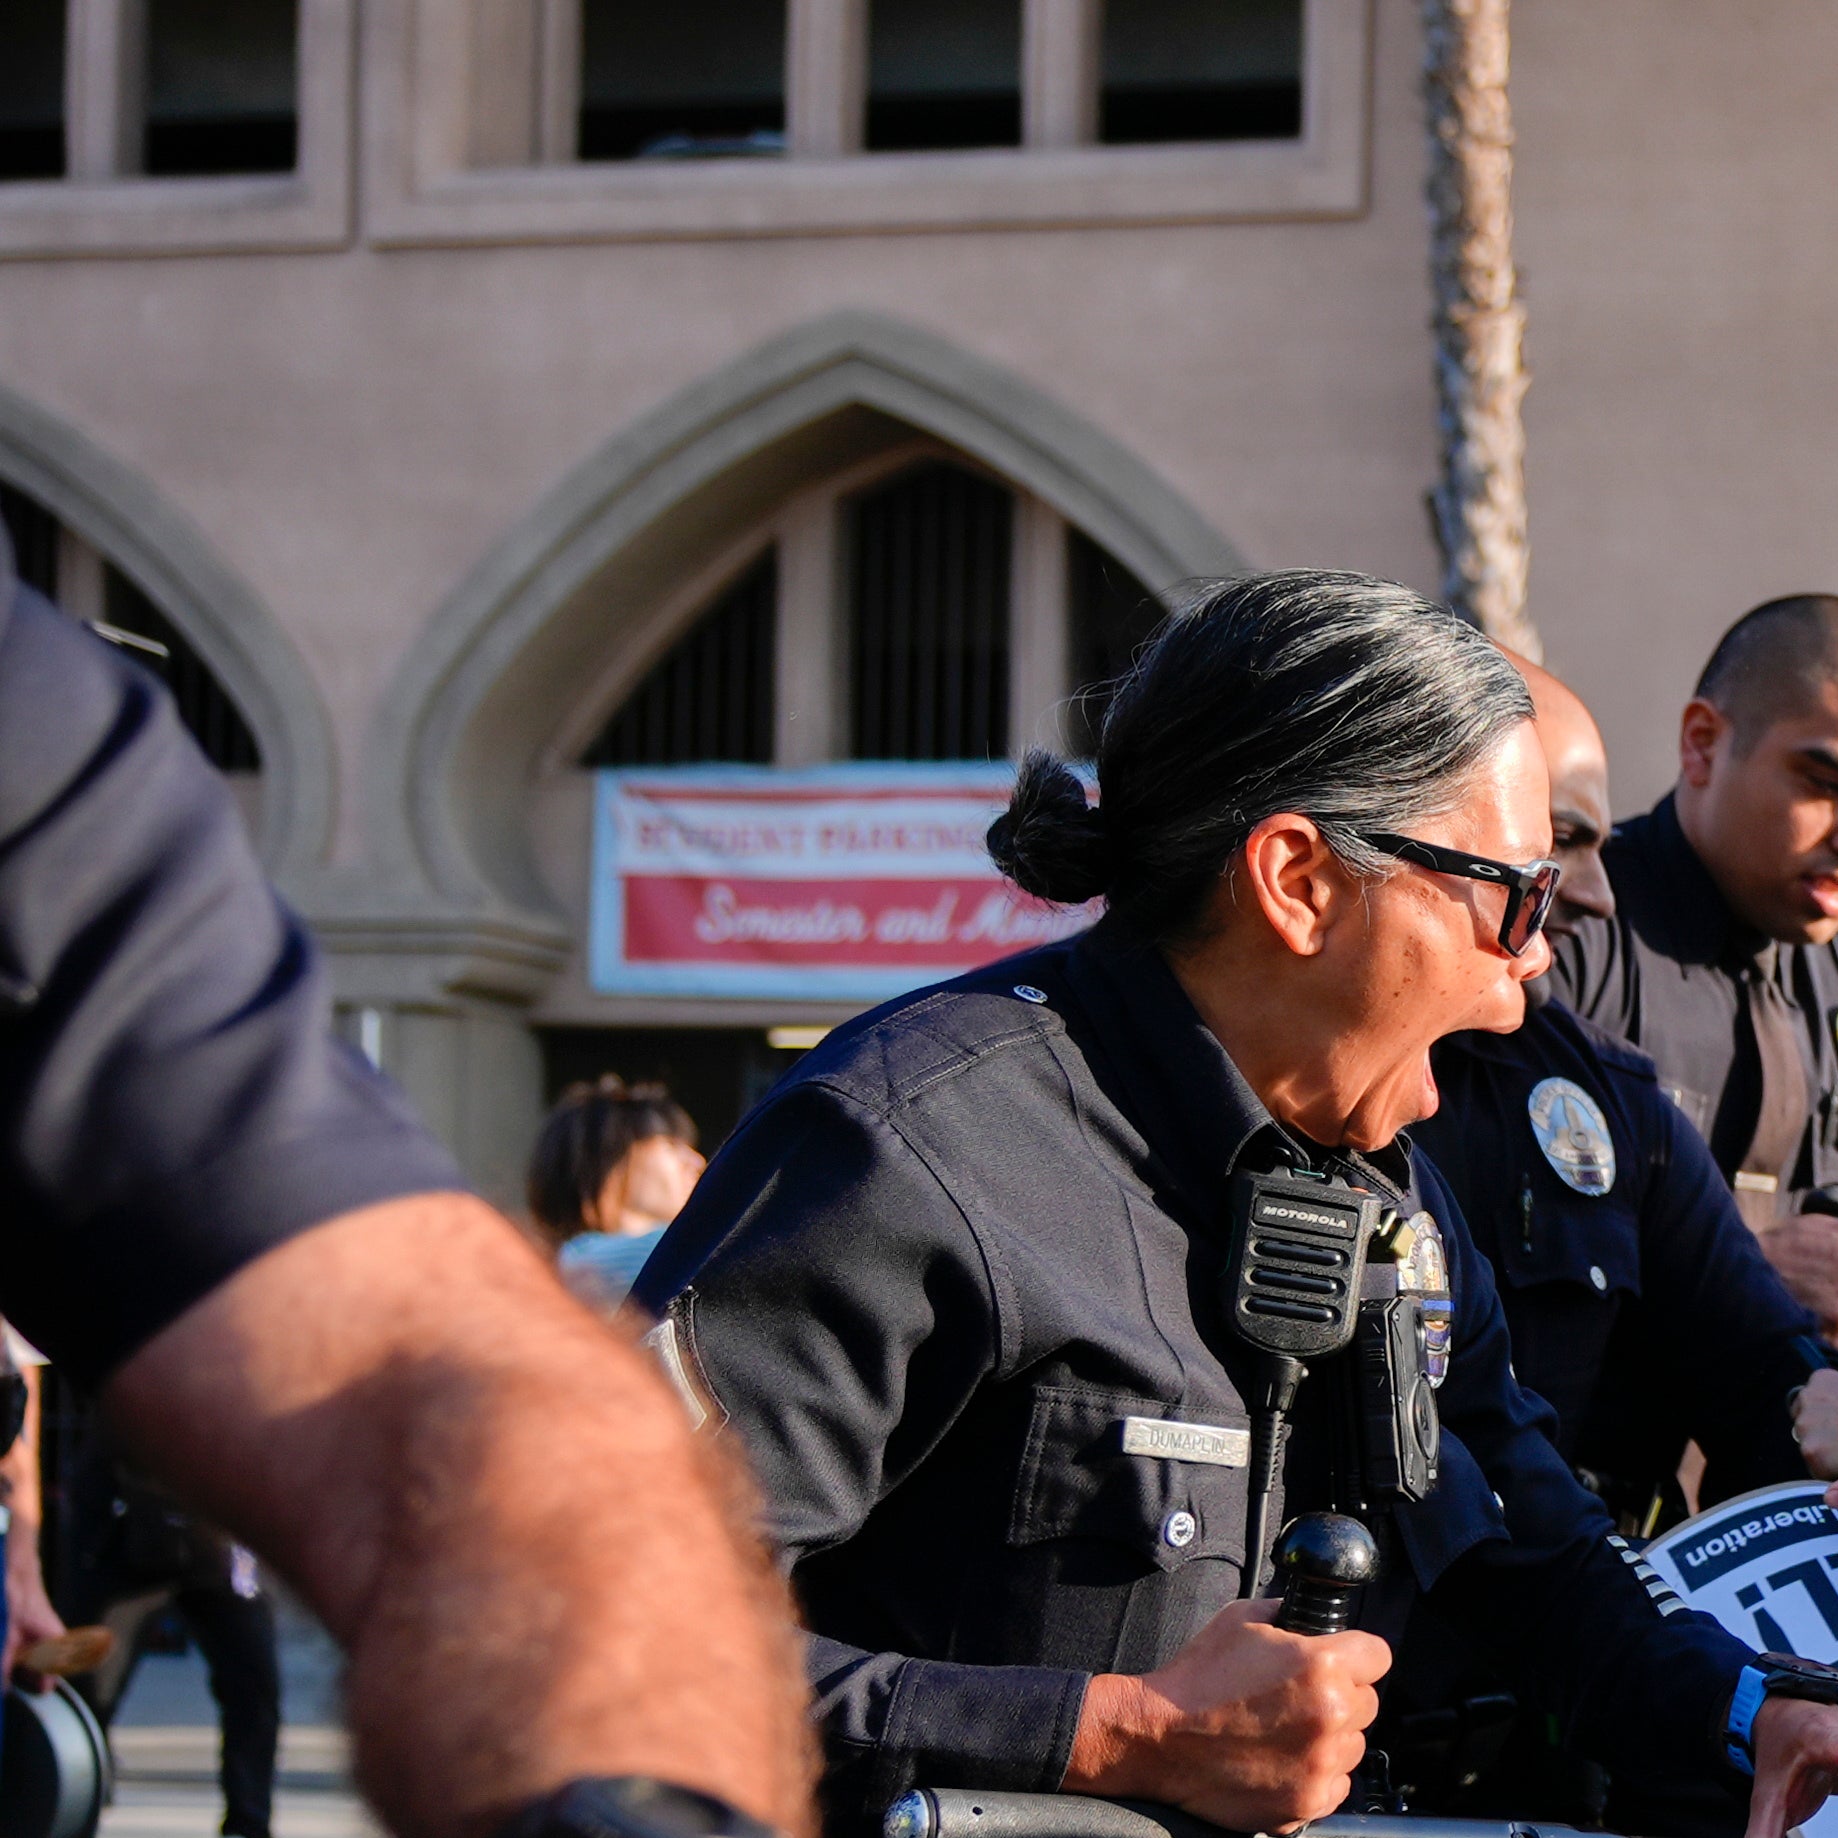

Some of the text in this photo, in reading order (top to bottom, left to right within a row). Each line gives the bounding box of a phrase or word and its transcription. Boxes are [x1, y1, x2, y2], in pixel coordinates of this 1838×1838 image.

[694, 884, 867, 944] Semester
[875, 888, 954, 943] and
[1261, 1205, 1349, 1229] MOTOROLA
[1149, 1428, 1226, 1454] DUMAPLIN
